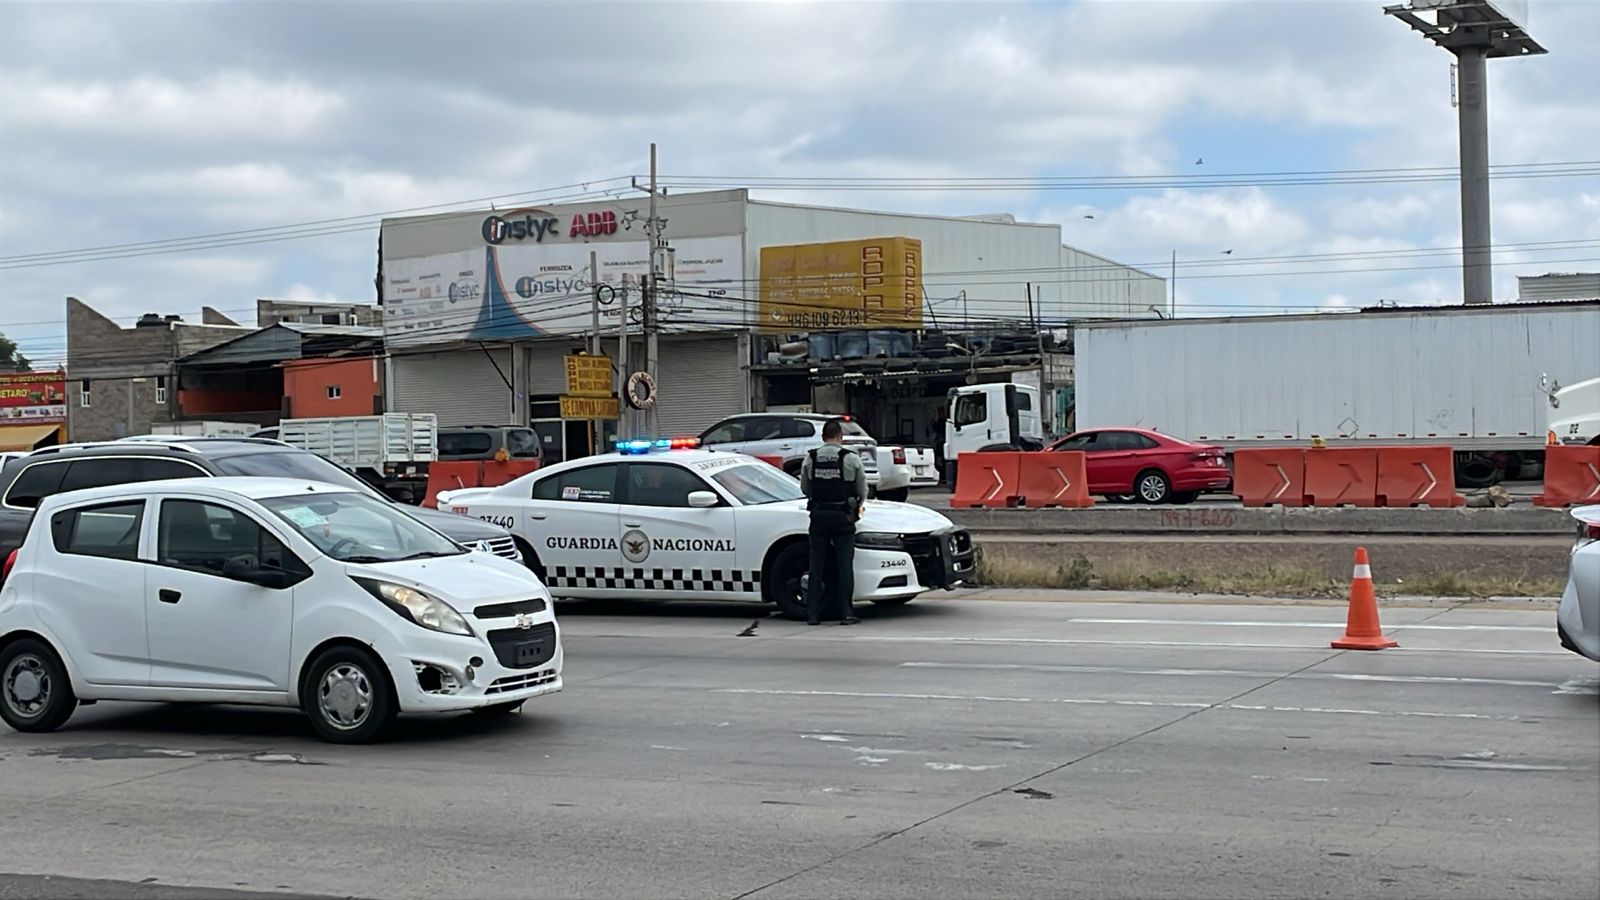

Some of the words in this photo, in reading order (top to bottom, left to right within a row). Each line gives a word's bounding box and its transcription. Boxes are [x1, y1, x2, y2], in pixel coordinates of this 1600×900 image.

[570, 211, 617, 237] ABB
[546, 537, 618, 550] GUARDIA
[653, 539, 736, 552] NACIONAL
[881, 560, 906, 568] 23440
